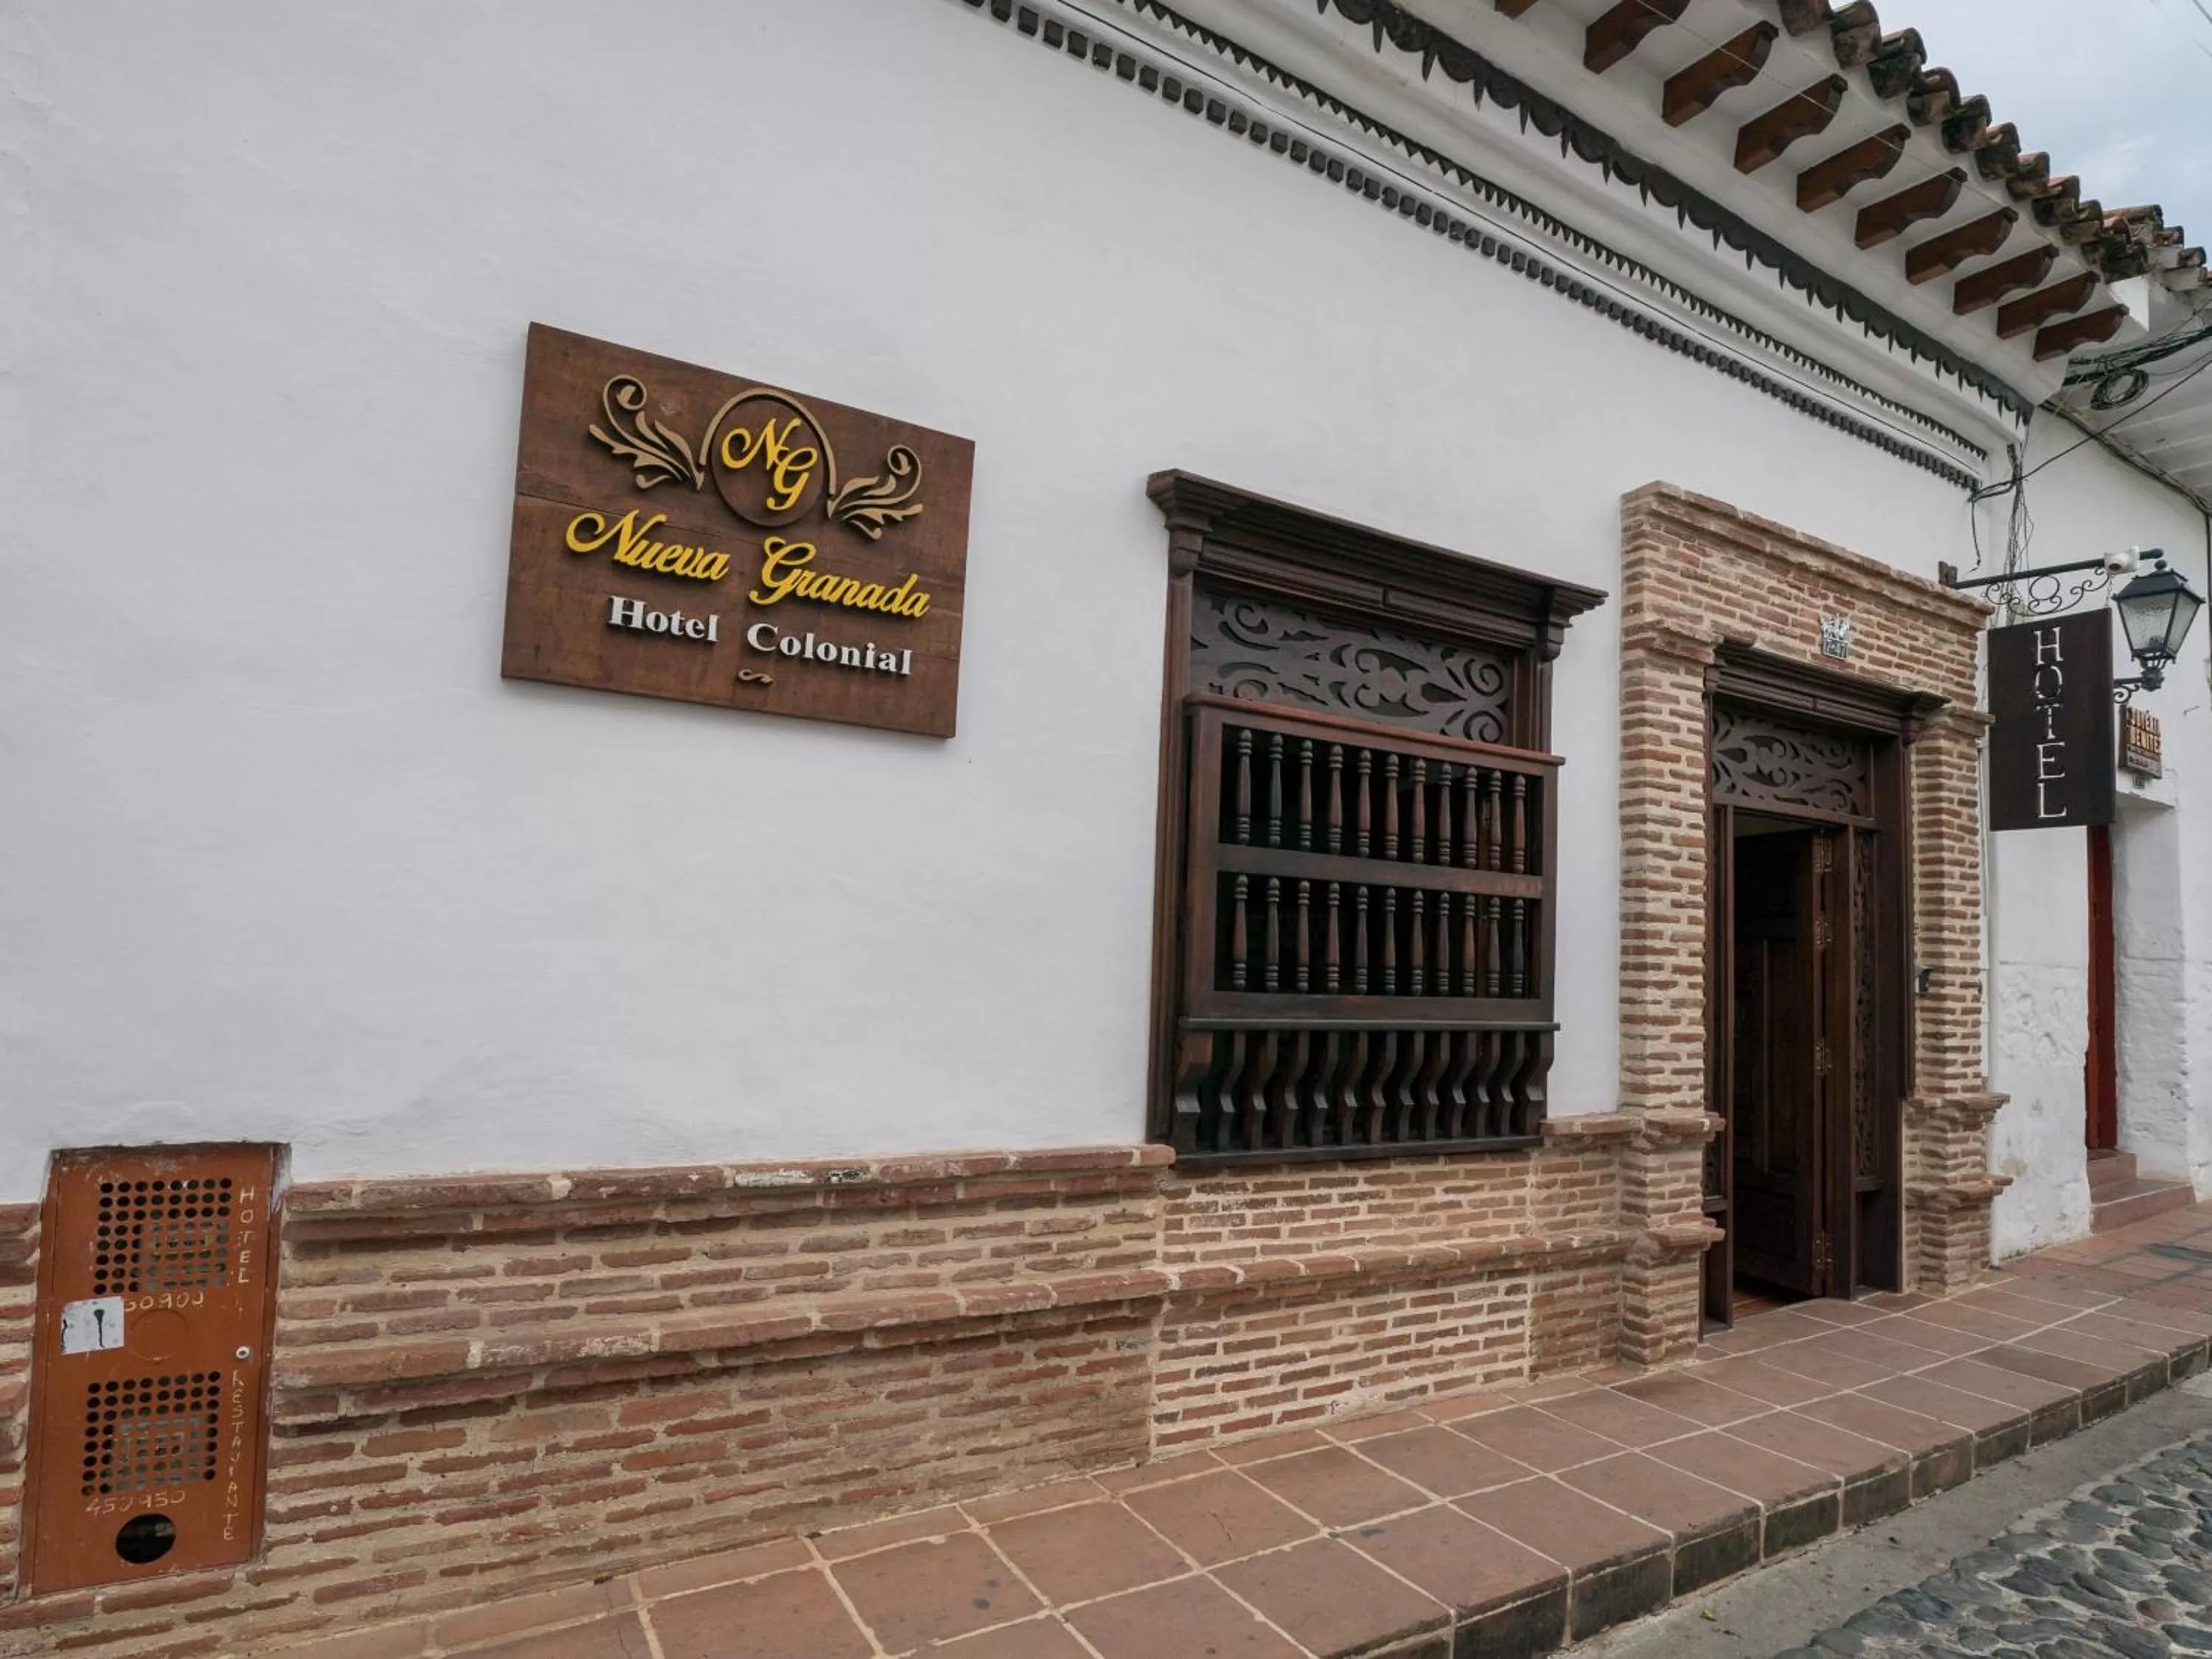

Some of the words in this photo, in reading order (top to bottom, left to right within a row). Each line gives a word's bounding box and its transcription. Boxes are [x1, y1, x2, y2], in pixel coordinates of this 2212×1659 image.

[566, 510, 729, 581] Nueva
[748, 535, 931, 619] Granada
[608, 596, 719, 642] Hotel
[746, 622, 913, 676] Colonial
[2034, 627, 2067, 819] HOTEL
[237, 1186, 256, 1284] HOTEL
